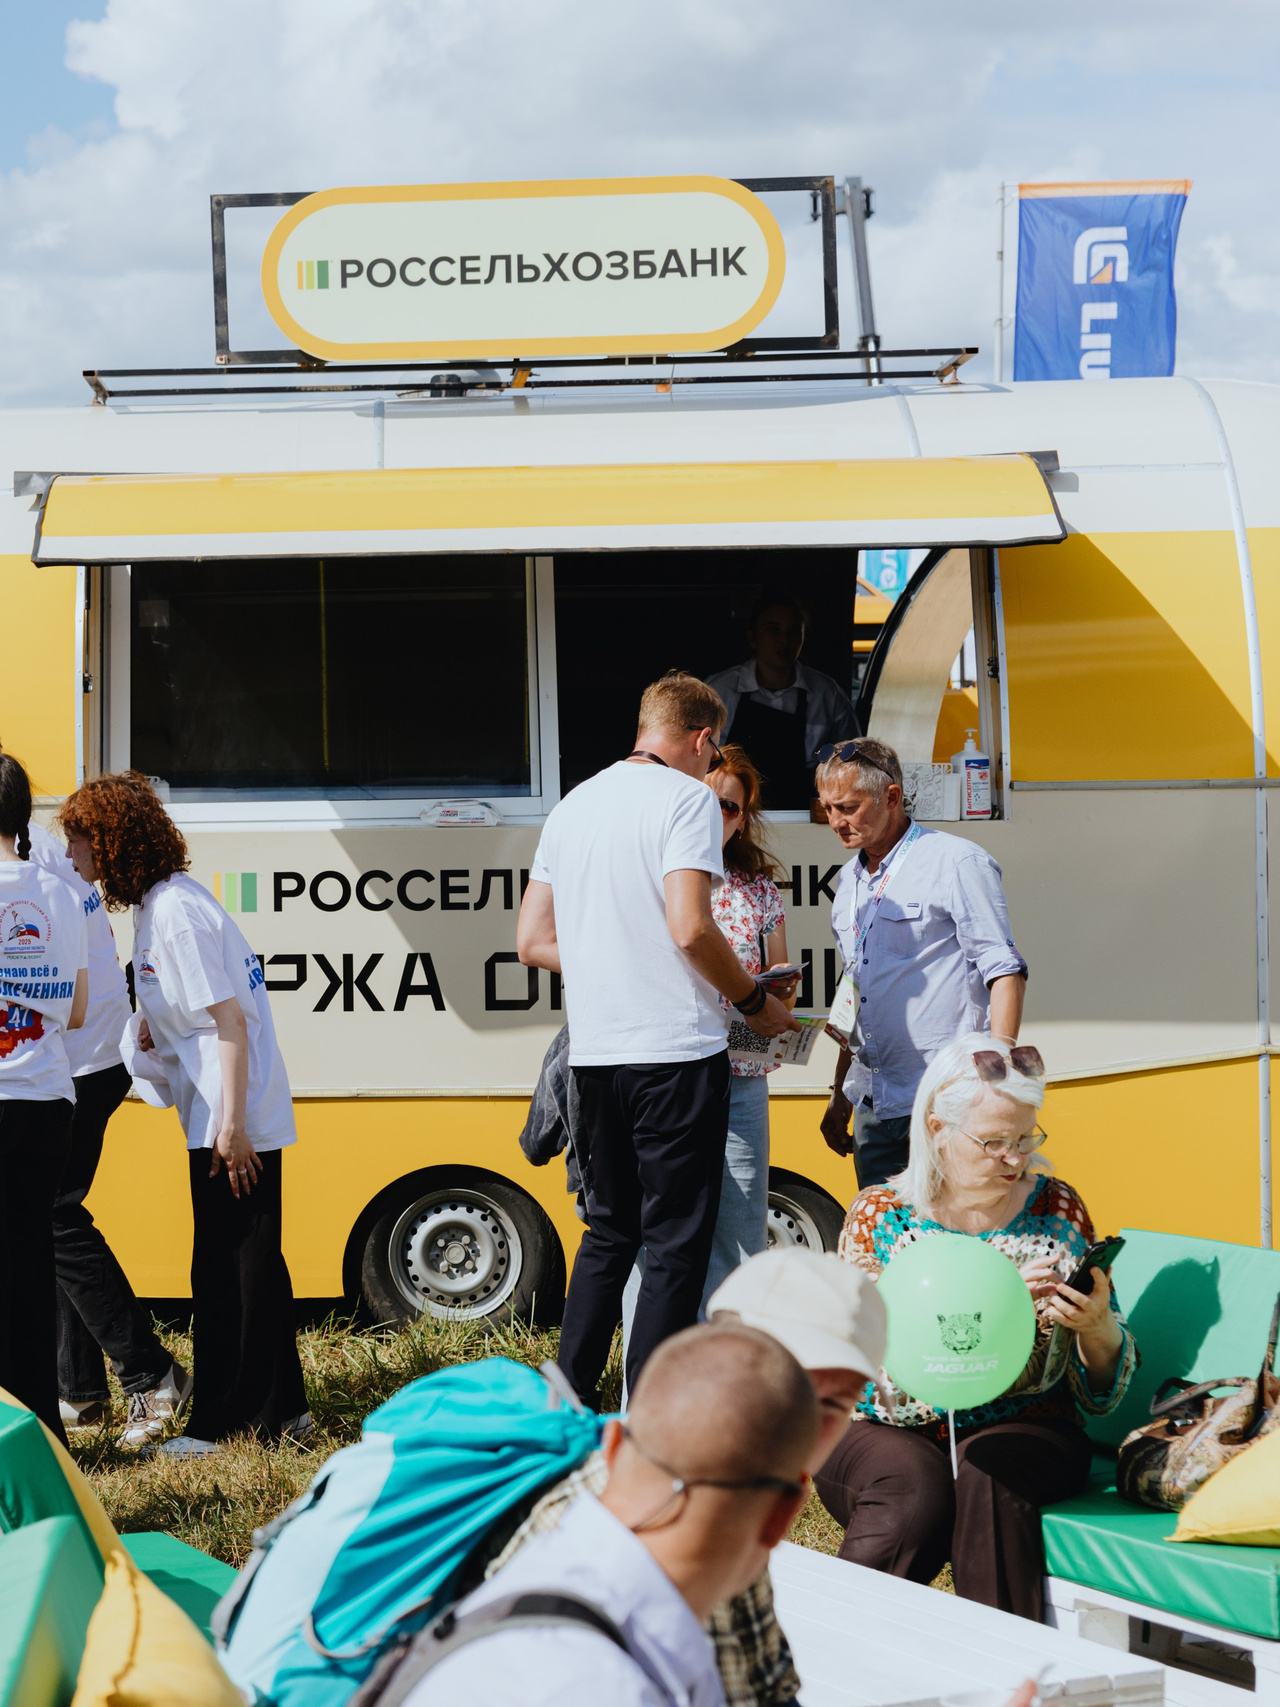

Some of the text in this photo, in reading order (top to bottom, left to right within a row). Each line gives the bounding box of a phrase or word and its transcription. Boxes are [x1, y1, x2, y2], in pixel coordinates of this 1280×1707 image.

[340, 245, 749, 290] РОССЕЛЬХОЗБАНК
[30, 965, 50, 977] всё
[52, 967, 58, 977] о
[8, 1006, 30, 1028] 47
[922, 1359, 999, 1374] JAGUAR
